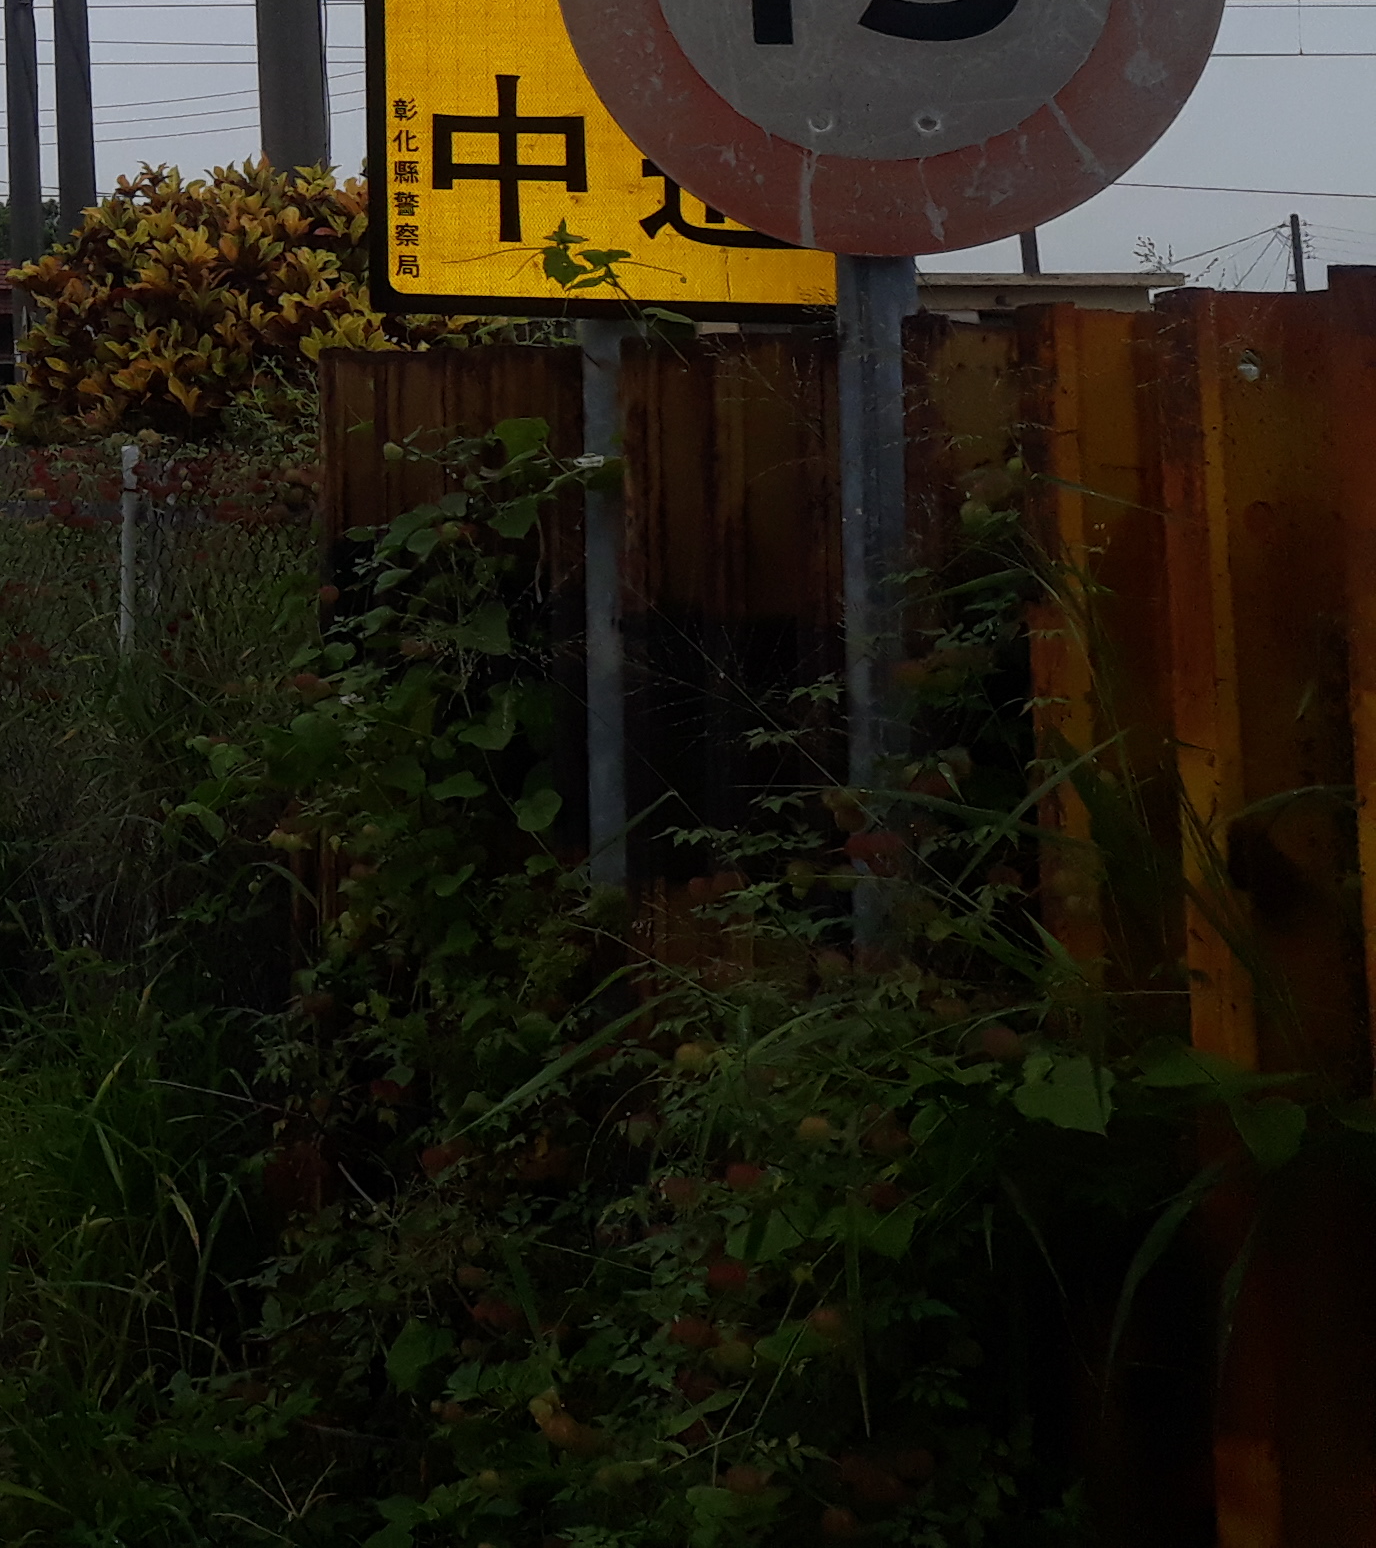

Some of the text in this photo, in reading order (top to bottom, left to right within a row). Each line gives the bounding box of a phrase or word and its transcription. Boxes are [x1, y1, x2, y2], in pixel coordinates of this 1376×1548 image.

[392, 98, 421, 279] 彰化縣警察局
